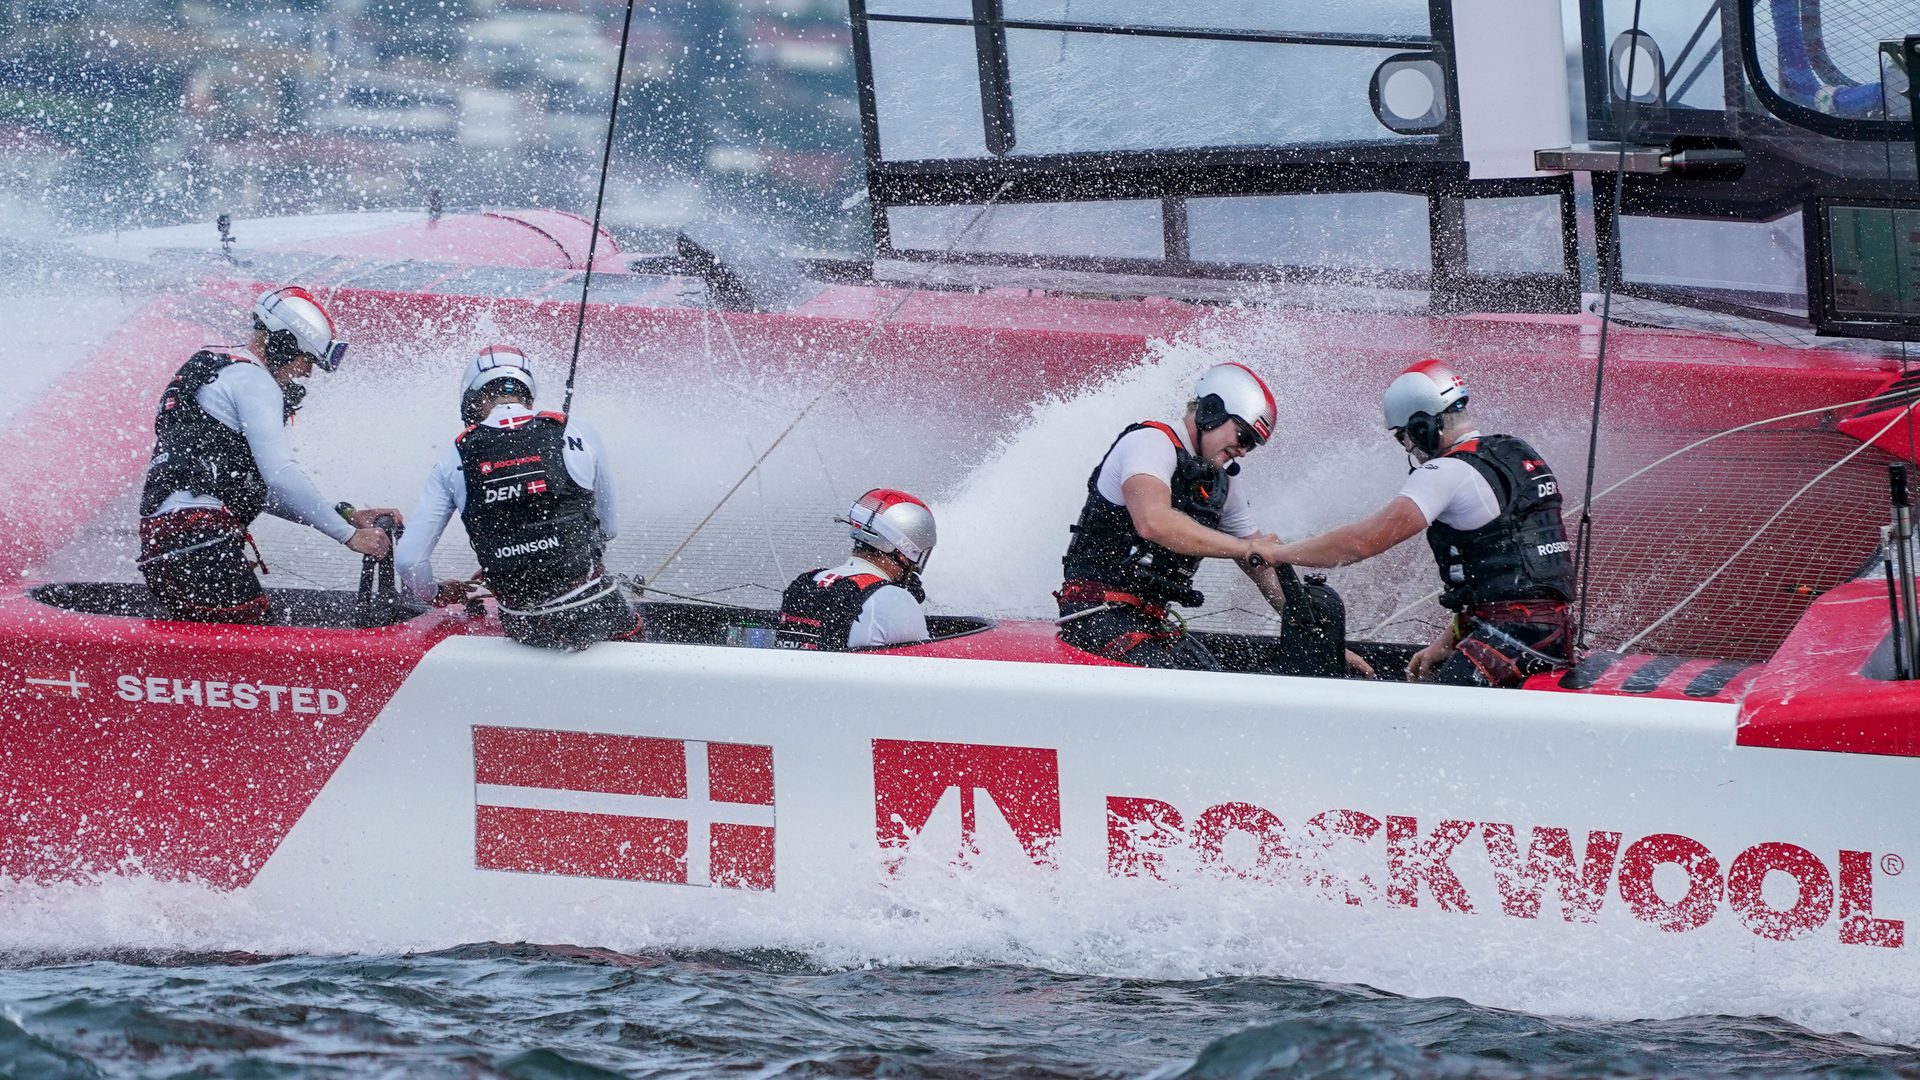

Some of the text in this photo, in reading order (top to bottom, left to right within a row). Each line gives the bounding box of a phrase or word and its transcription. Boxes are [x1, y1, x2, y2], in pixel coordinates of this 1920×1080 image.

[484, 483, 522, 504] DEN
[494, 534, 560, 559] JOHNSON
[116, 675, 348, 715] SEHESTED
